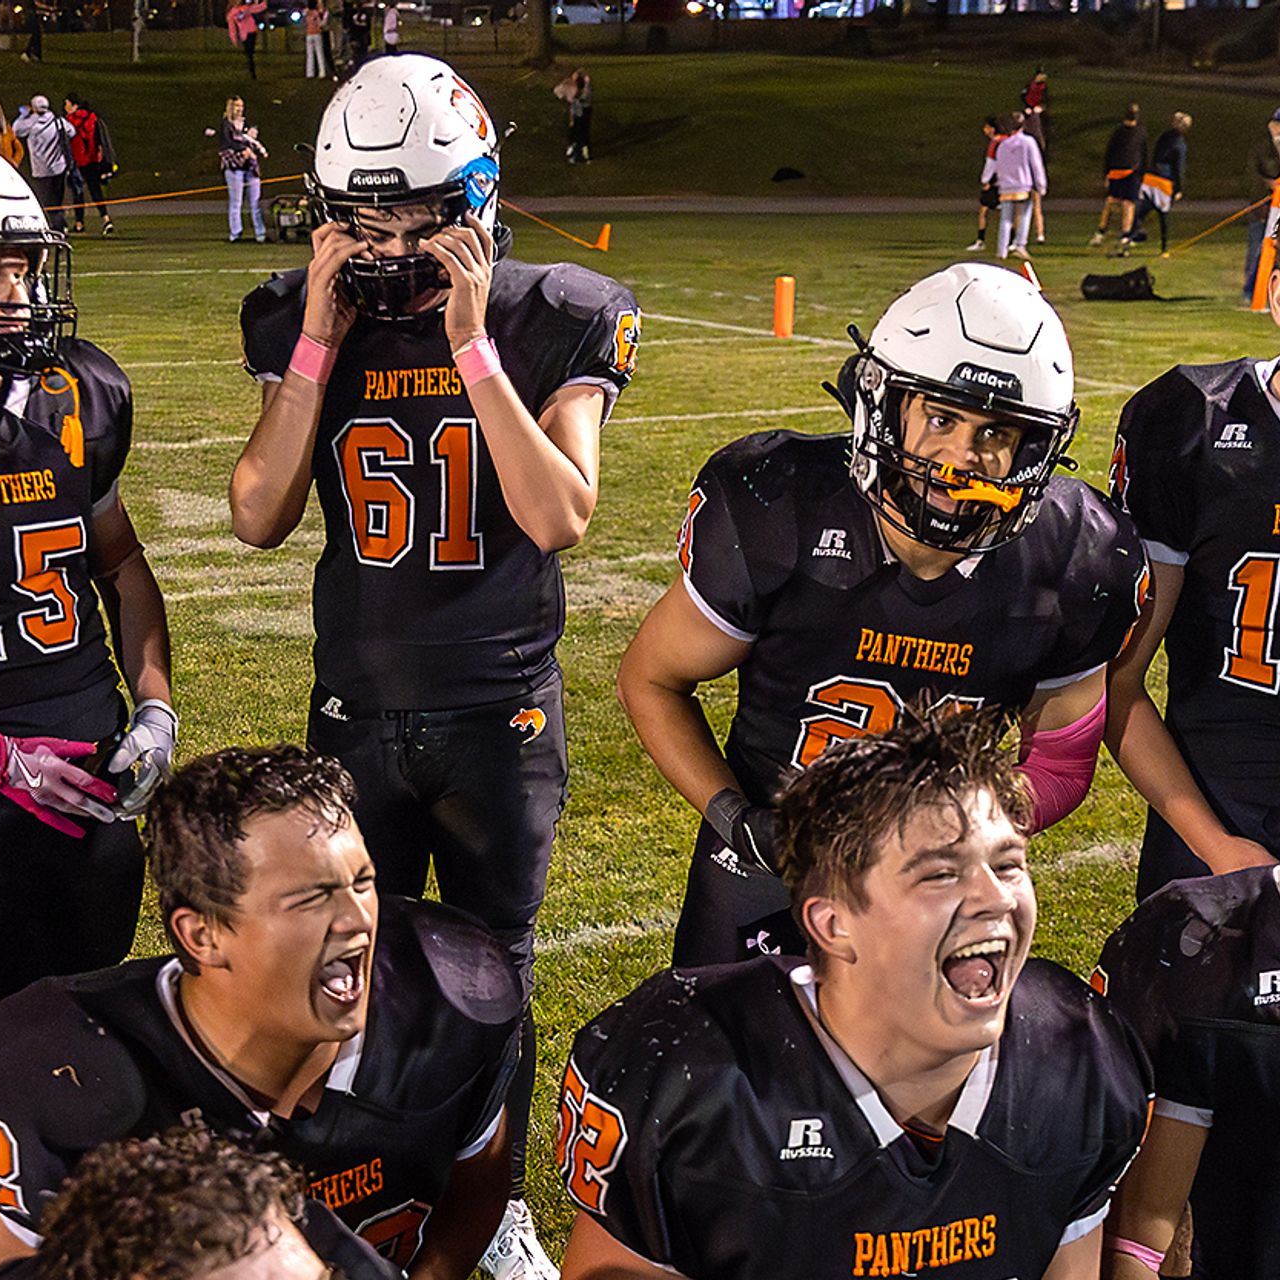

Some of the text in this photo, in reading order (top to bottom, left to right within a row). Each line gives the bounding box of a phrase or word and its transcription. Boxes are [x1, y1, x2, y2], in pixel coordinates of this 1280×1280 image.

[364, 367, 463, 400] PANTHERS
[1213, 439, 1254, 450] RUSSELL
[331, 417, 485, 571] 61
[812, 547, 852, 561] RUSSELL
[855, 628, 975, 677] PANTHERS
[788, 1118, 824, 1148] R
[779, 1147, 835, 1161] RUSSELL
[852, 1214, 998, 1278] PANTHERS
